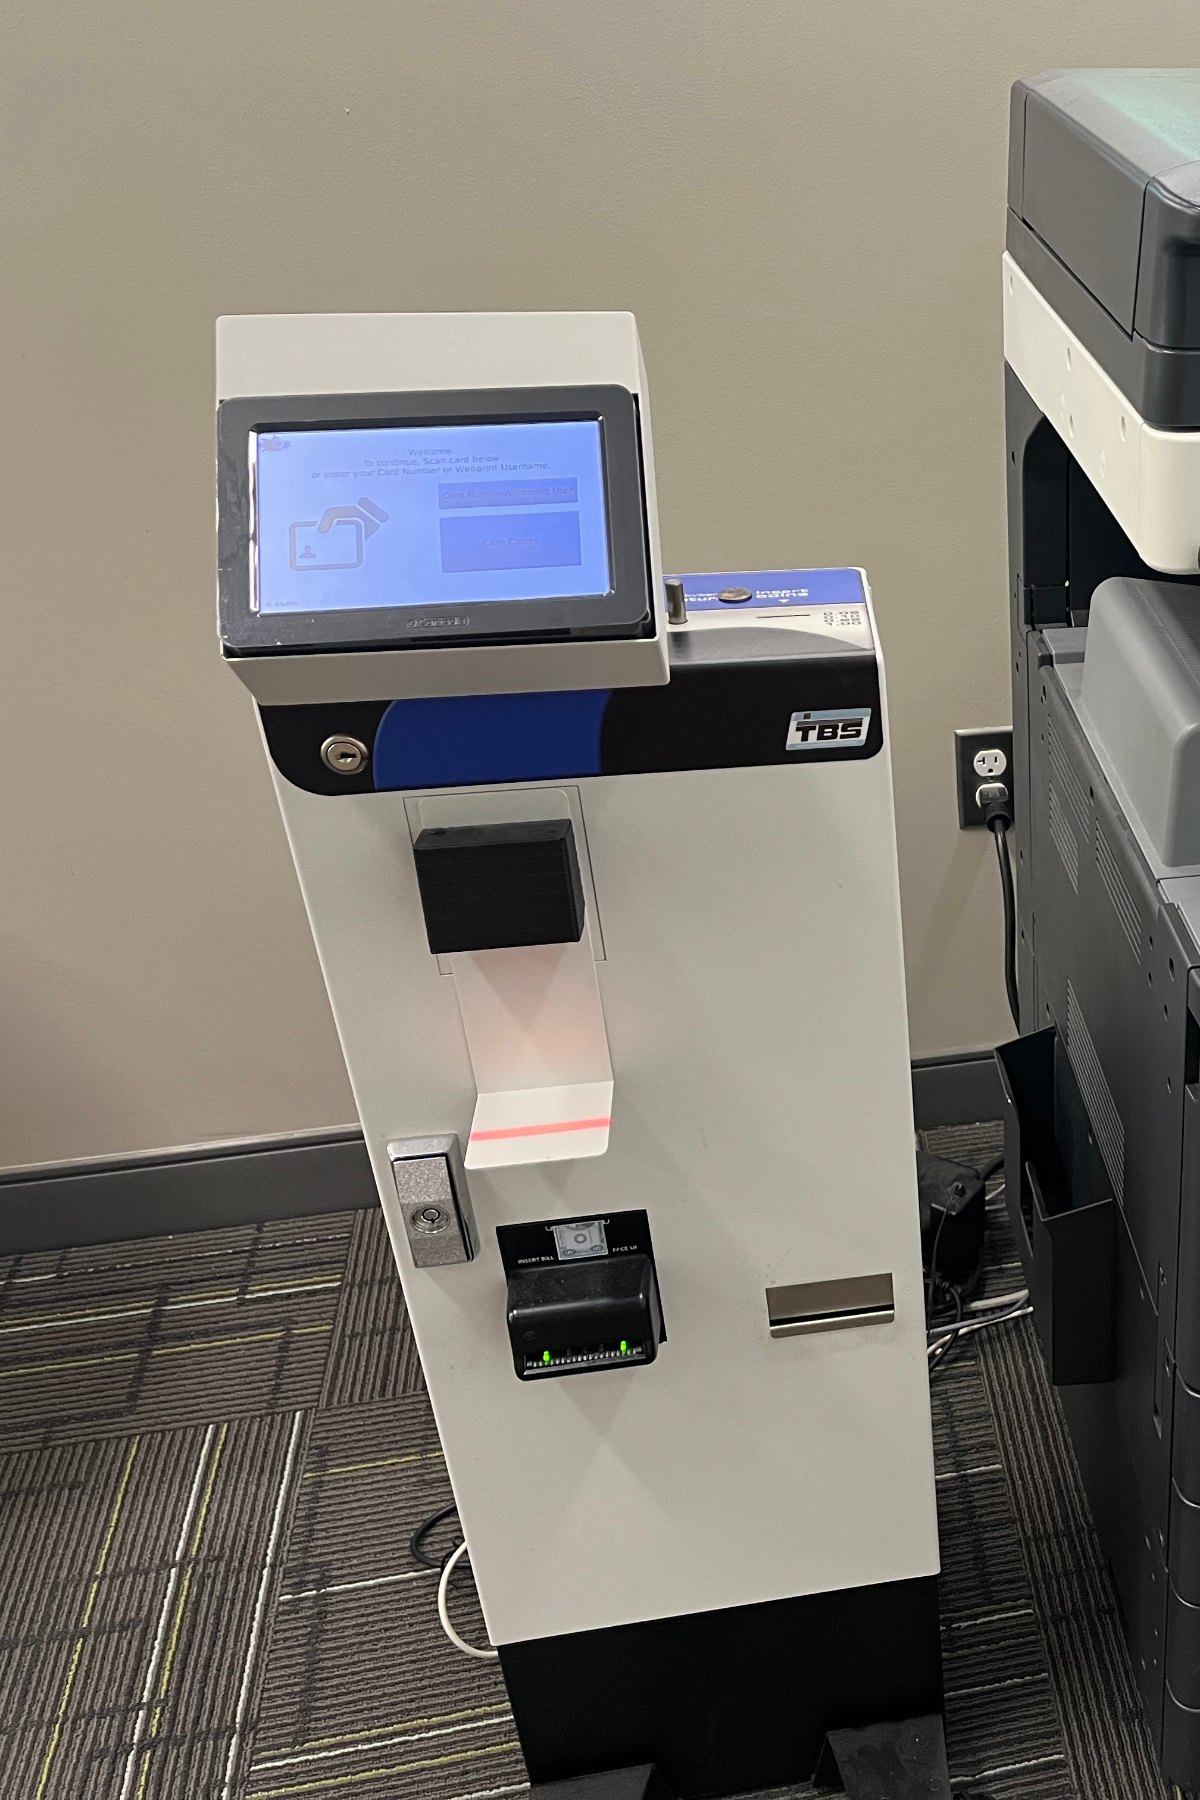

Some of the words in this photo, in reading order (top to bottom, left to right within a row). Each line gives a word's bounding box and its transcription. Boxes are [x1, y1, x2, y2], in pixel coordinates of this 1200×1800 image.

[364, 459, 374, 467] To
[423, 457, 447, 465] Scan
[449, 456, 469, 464] card
[472, 455, 500, 463] below
[353, 470, 375, 479] your
[377, 468, 400, 476] Card
[402, 467, 440, 475] Number
[455, 464, 498, 473] Webprint
[482, 538, 506, 547] Cash
[508, 537, 539, 547] Copies
[517, 1257, 540, 1265] INSERT
